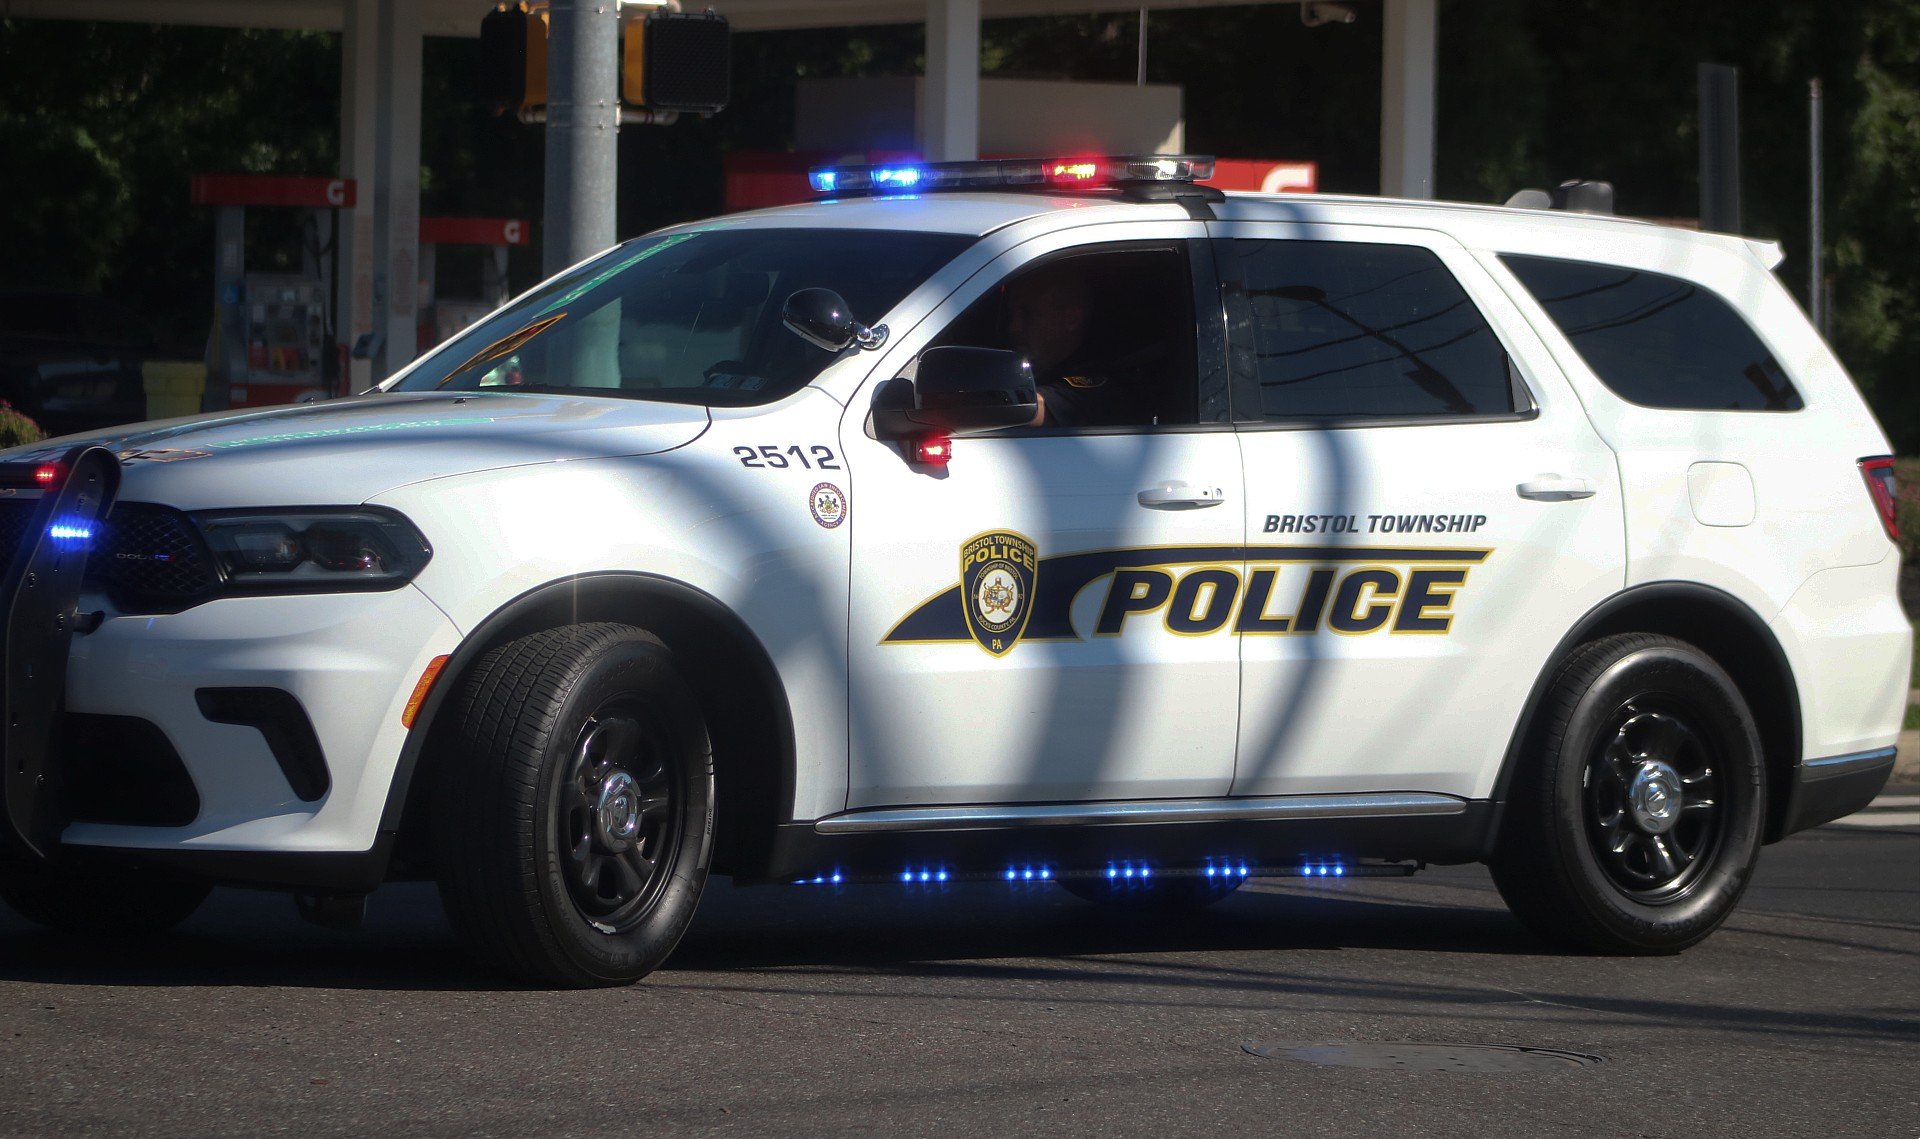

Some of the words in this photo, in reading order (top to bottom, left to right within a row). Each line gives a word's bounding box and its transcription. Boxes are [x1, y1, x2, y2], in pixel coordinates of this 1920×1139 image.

[326, 181, 345, 206] G
[504, 220, 520, 243] G
[733, 446, 841, 470] 2512
[1262, 514, 1359, 533] BRISTOL
[1367, 514, 1487, 533] TOWNSHIP
[963, 537, 994, 558] BRISTOL
[995, 535, 1034, 557] TOWNSHIP
[963, 546, 1034, 573] POLICE
[1093, 565, 1471, 637] POLICE
[992, 639, 1002, 649] PA
